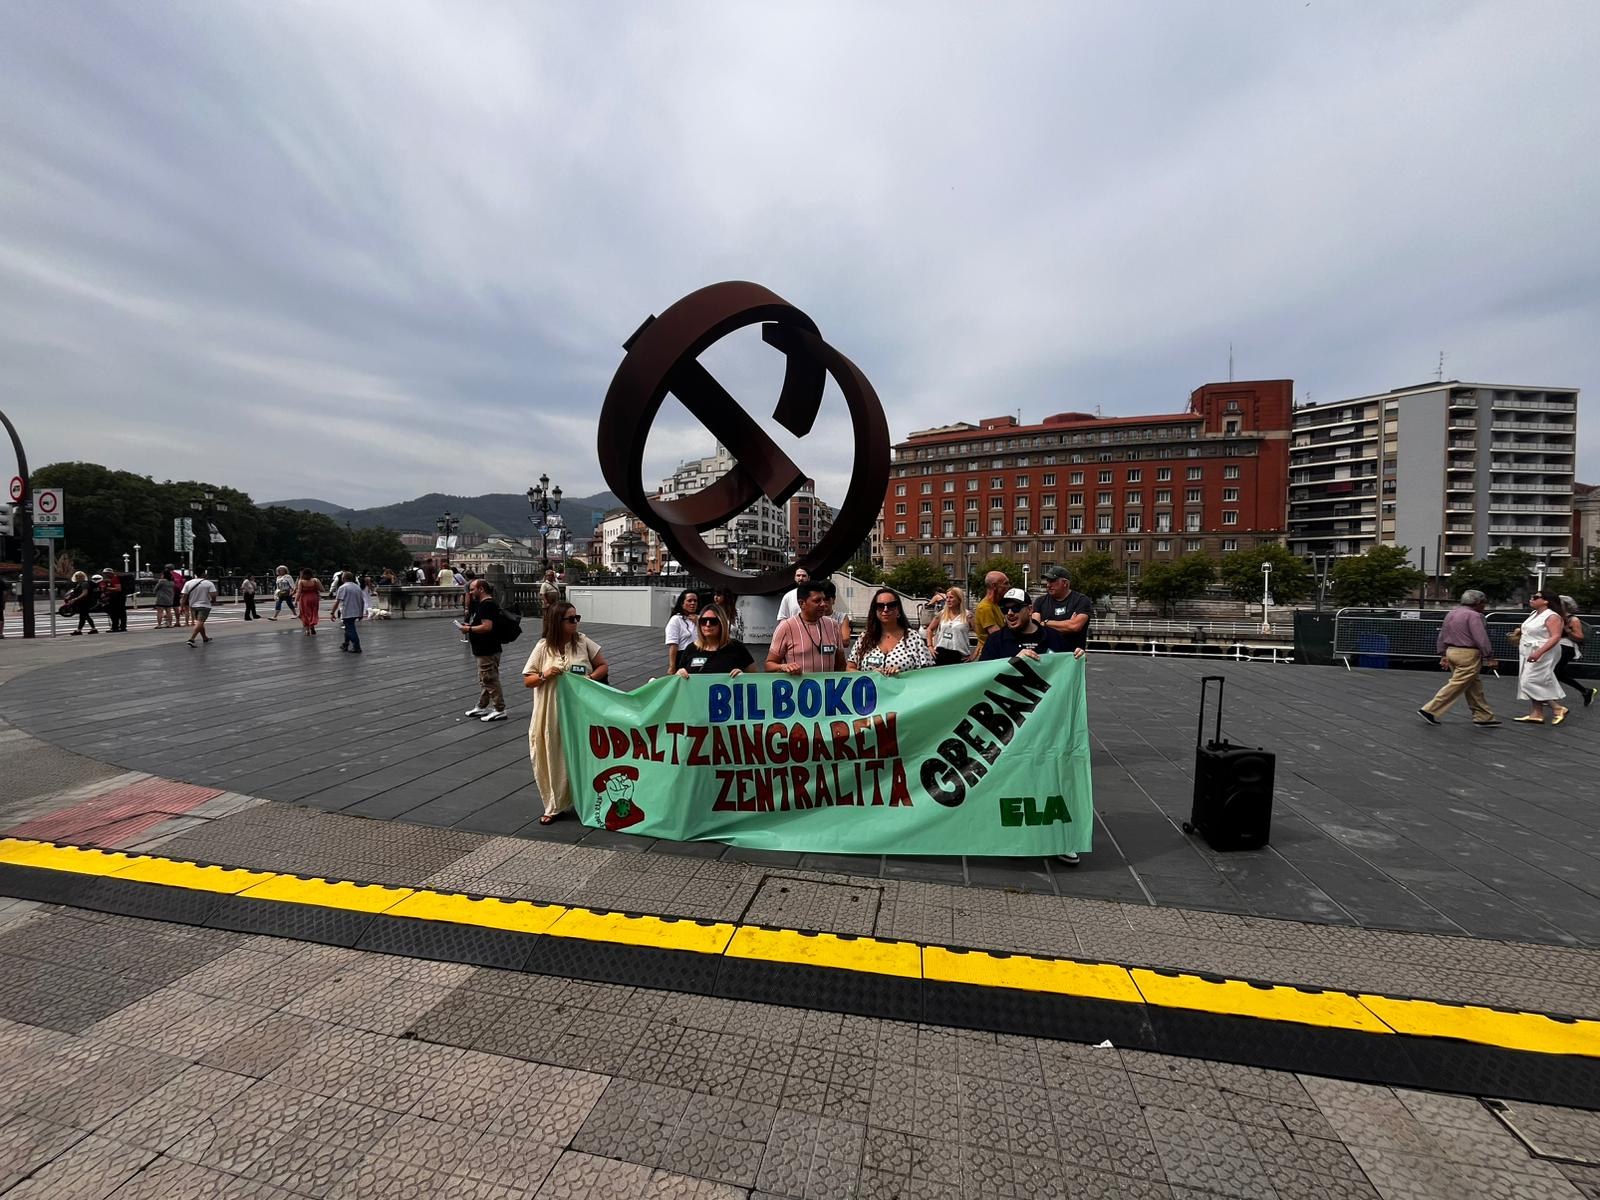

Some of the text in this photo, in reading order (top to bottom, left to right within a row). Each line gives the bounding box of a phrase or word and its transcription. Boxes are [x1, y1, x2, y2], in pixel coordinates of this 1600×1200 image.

[589, 712, 899, 766] UDALTZAINGOAREN
[920, 657, 1052, 807] GREBAN
[712, 758, 913, 812] ZENTRALITA
[1000, 795, 1072, 827] ELA
